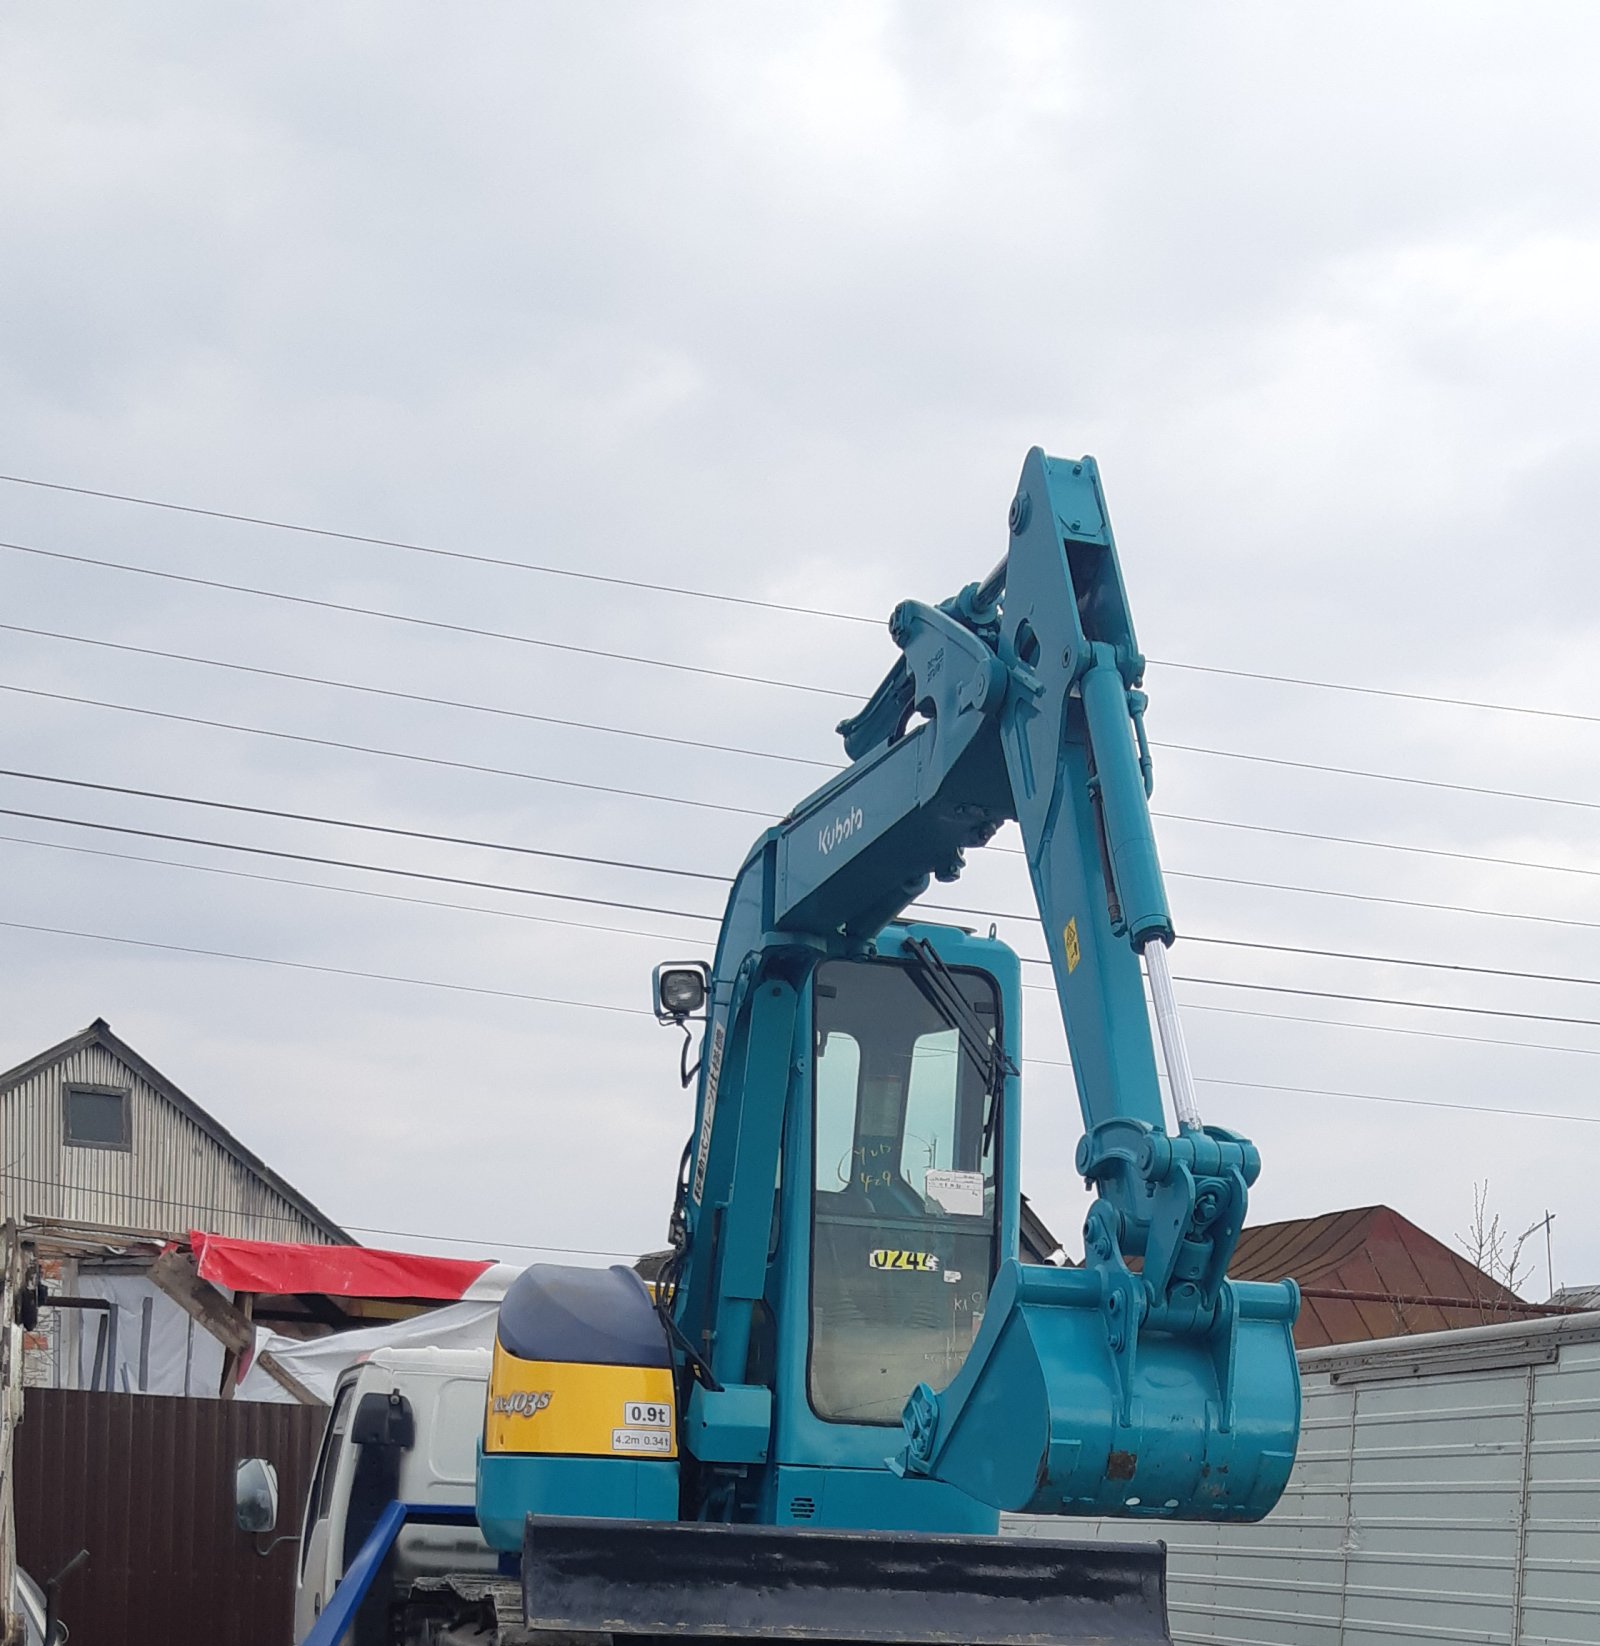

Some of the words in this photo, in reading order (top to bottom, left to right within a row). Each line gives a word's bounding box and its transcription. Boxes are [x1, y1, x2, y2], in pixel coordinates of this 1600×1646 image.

[818, 805, 863, 855] Kubota
[631, 1406, 666, 1423] 0.9t
[615, 1435, 640, 1445] 4.2m
